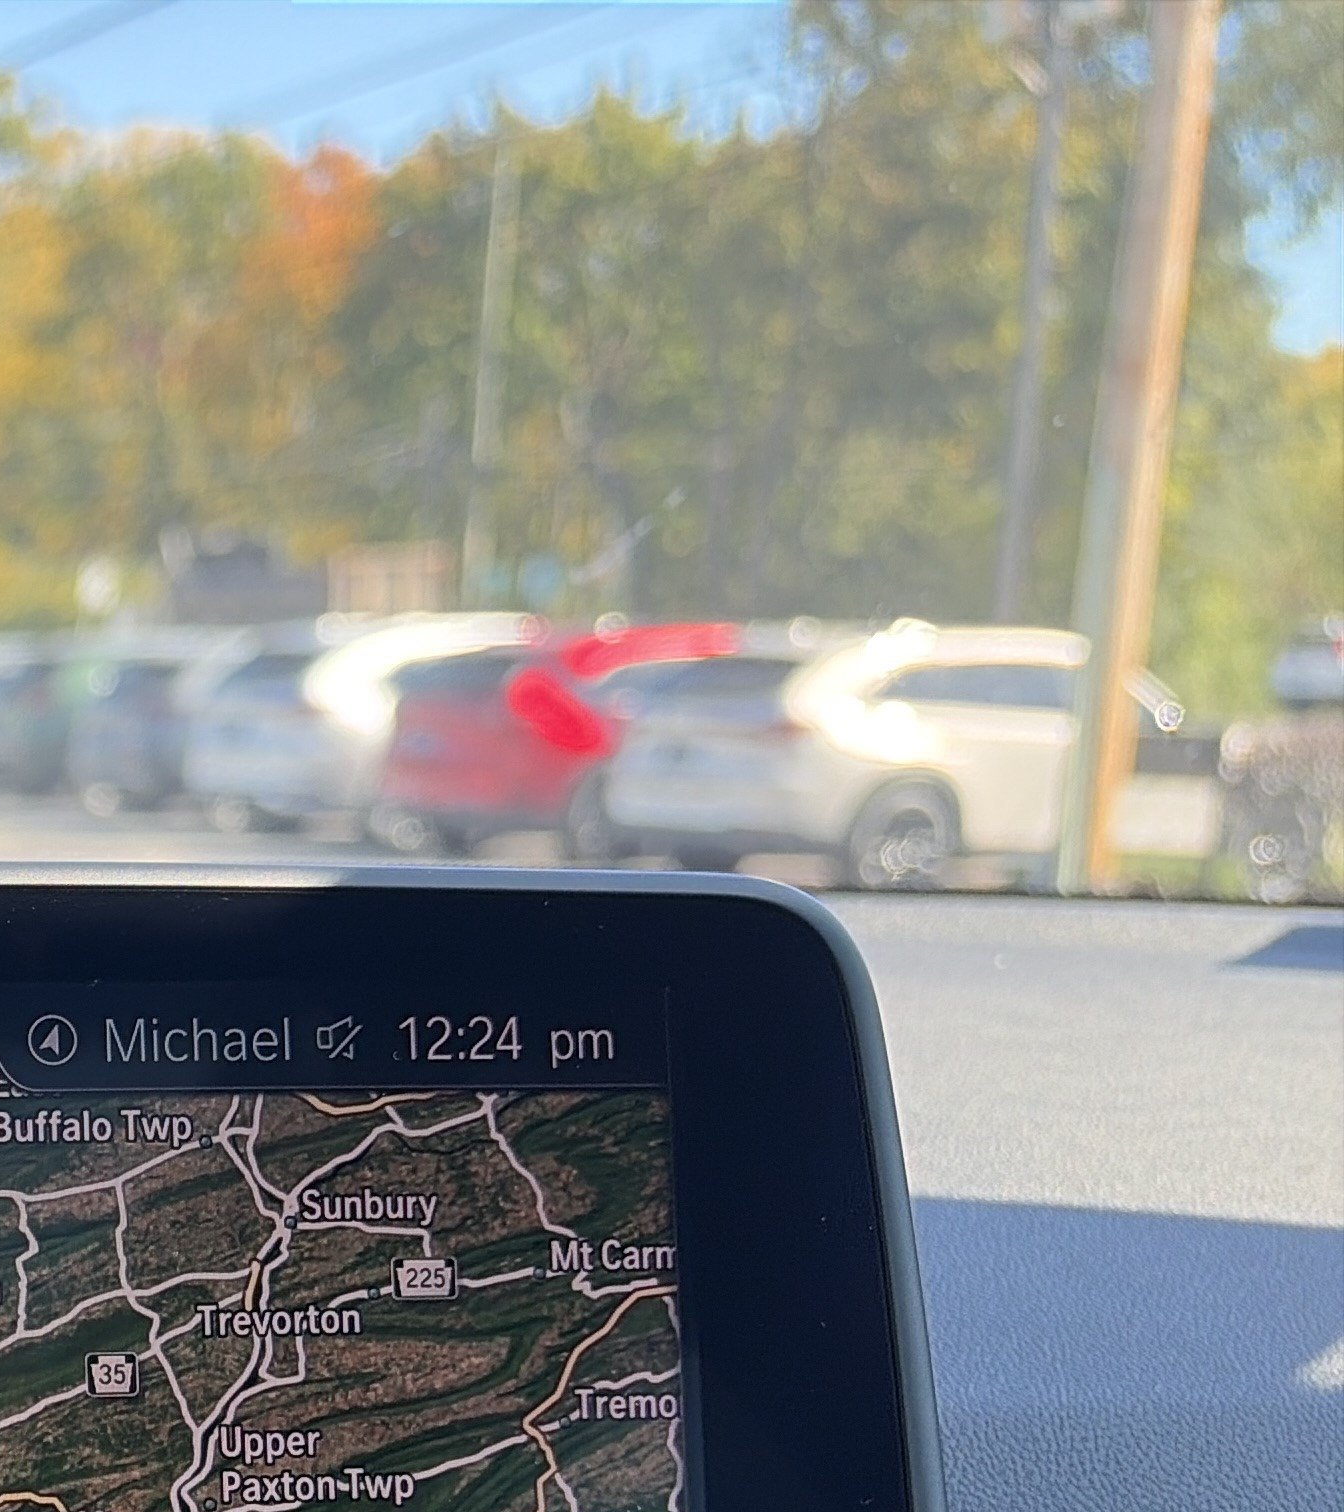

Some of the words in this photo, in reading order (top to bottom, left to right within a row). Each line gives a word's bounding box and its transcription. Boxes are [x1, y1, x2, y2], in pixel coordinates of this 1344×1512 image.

[106, 1017, 291, 1063] Michael
[399, 1017, 522, 1061] 12:24
[550, 1028, 614, 1068] pm
[121, 1109, 192, 1146] Twp
[302, 1190, 437, 1224] Sunbury
[551, 1240, 593, 1270] Mt
[406, 1268, 445, 1289] 225
[198, 1305, 360, 1337] Trevorton
[98, 1363, 125, 1384] 35
[574, 1389, 677, 1419] Tremo
[220, 1426, 320, 1463] Upper
[222, 1472, 336, 1501] Paxton
[345, 1469, 414, 1505] Twp
